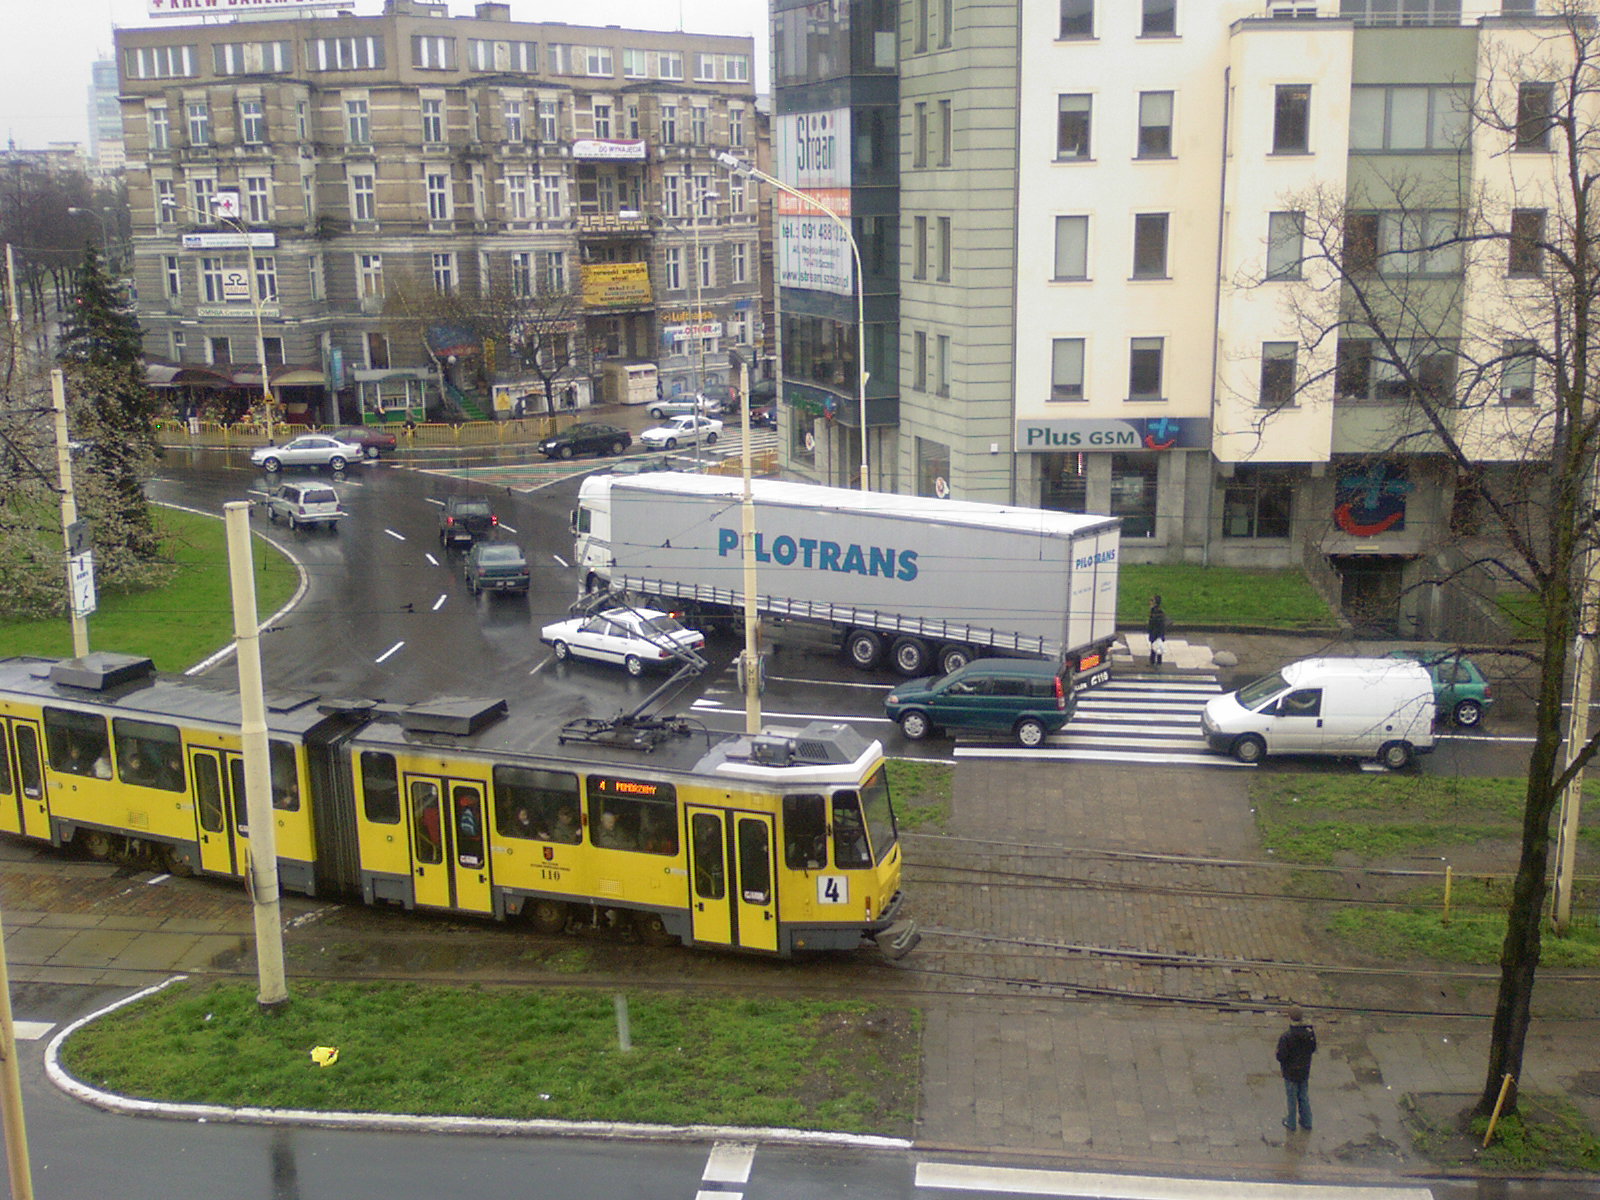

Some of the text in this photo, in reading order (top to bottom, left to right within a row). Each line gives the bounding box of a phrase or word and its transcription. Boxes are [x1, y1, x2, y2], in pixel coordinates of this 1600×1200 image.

[1027, 427, 1135, 446] Plus GSM
[718, 527, 919, 582] PLOTRANS
[825, 877, 840, 903] 4
